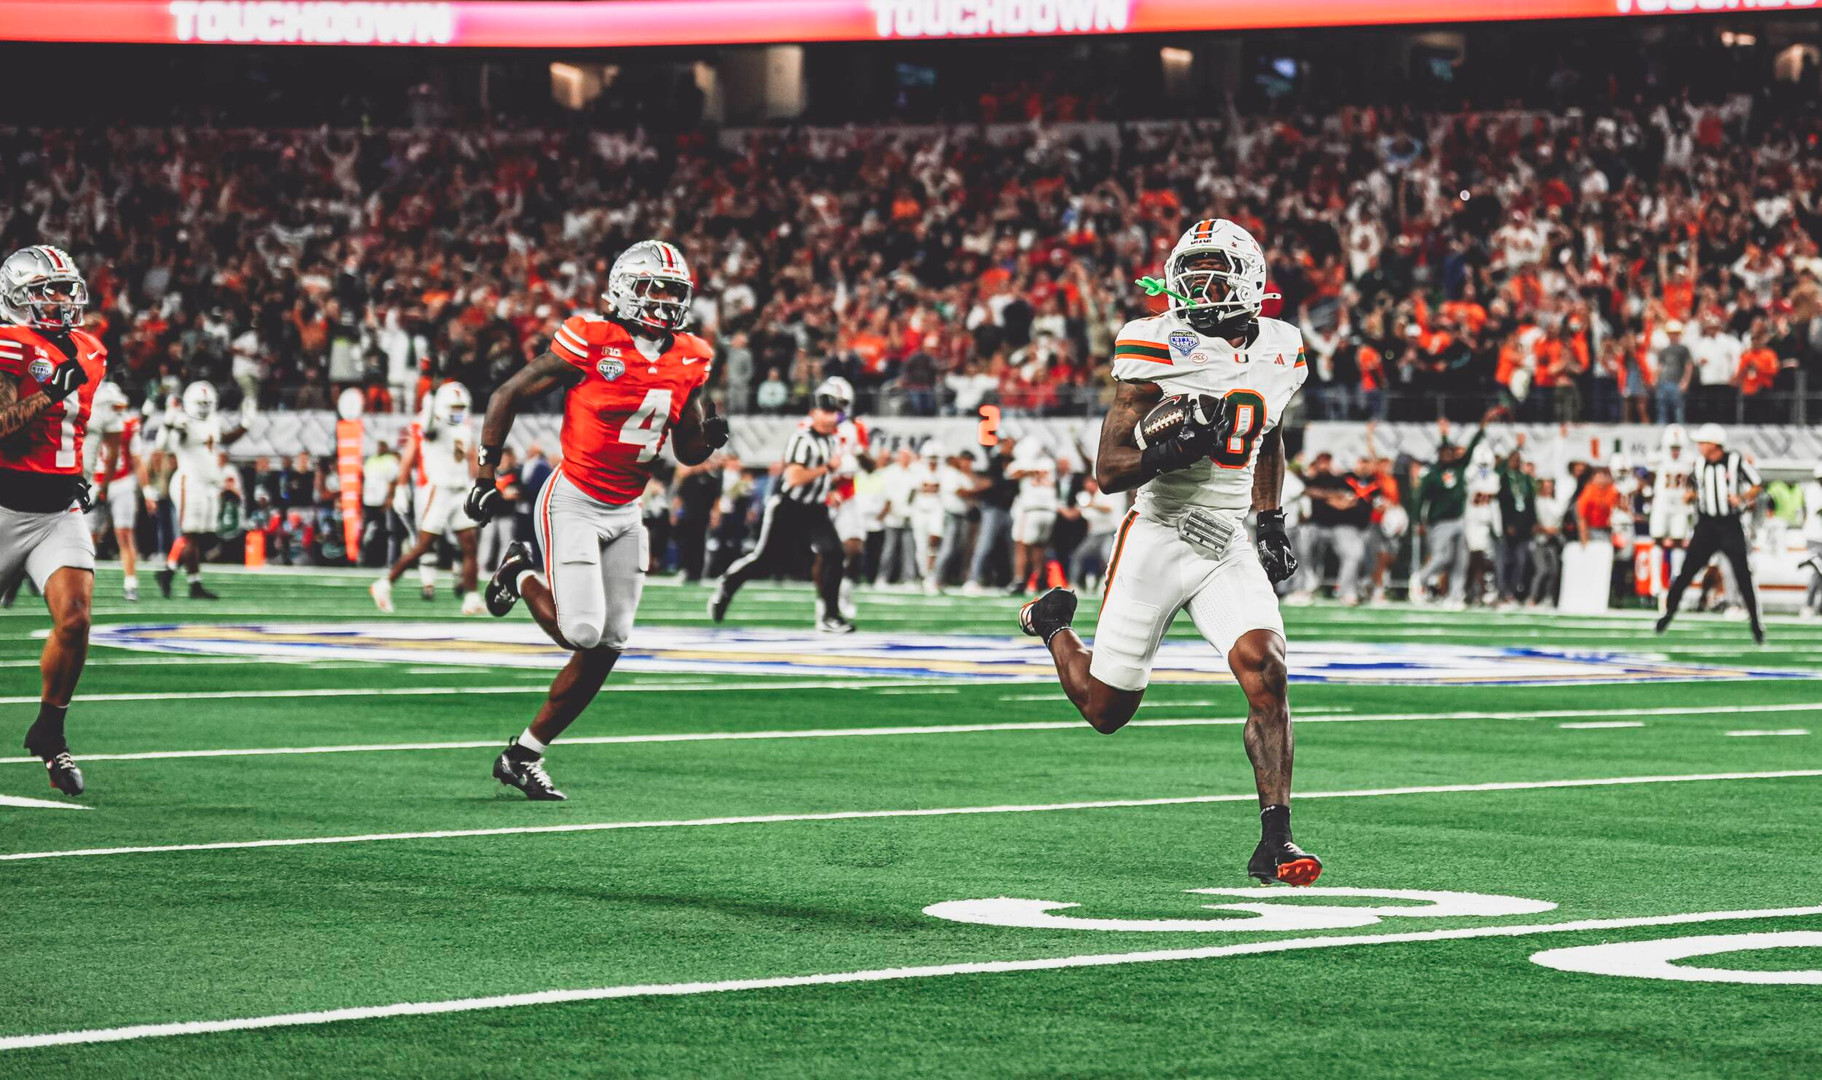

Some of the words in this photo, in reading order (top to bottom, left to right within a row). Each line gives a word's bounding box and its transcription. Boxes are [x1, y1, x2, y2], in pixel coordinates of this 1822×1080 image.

[169, 1, 451, 44] TOUCHDOWN
[870, 0, 1128, 38] TOUCHDOWN
[1191, 238, 1212, 246] MIAMI
[1233, 353, 1250, 364] U
[55, 388, 80, 468] 1
[618, 388, 672, 464] 4
[977, 404, 1001, 447] 2
[1209, 388, 1268, 470] 0
